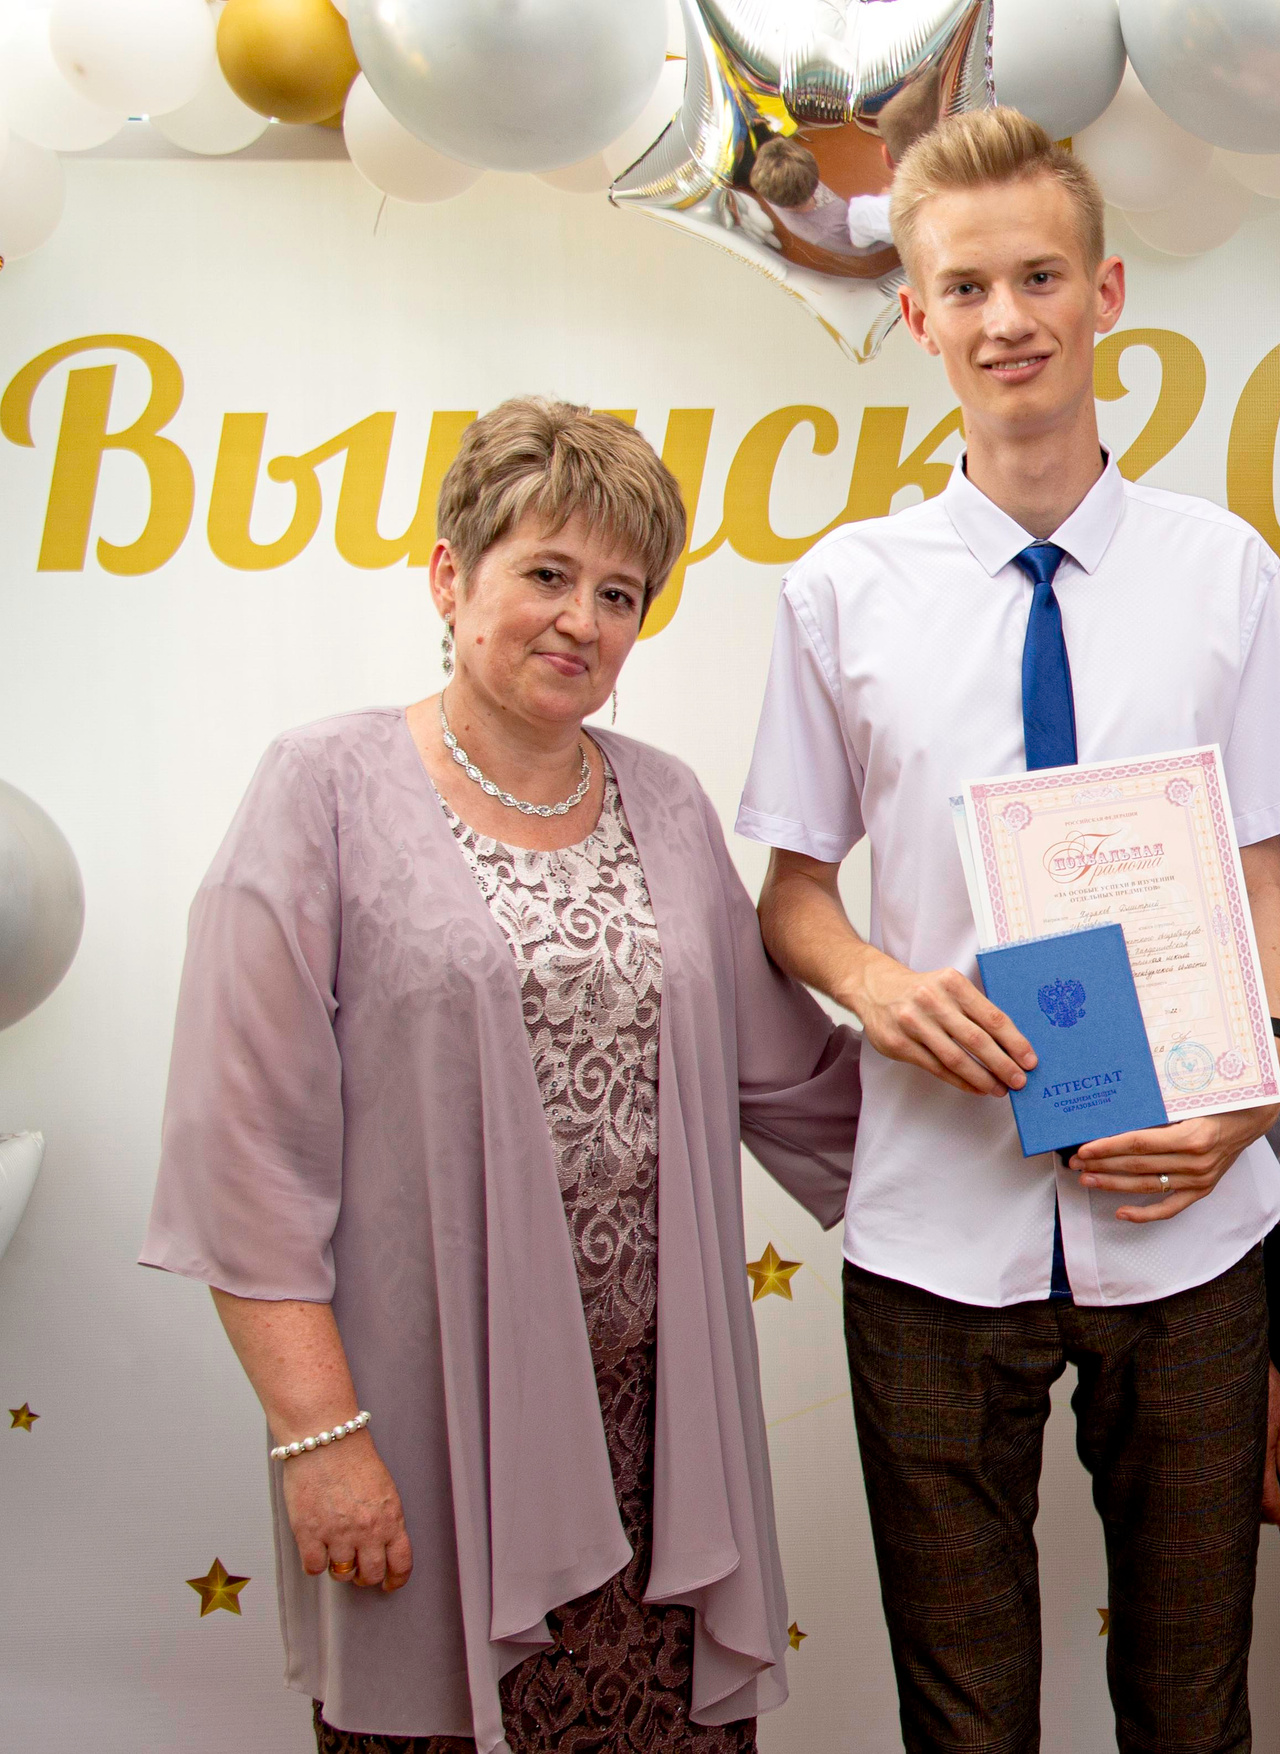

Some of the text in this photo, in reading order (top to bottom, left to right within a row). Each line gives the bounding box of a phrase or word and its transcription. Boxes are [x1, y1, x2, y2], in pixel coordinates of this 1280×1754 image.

[1065, 811, 1139, 827] РОССИЙСКАЯ ФЕДЕРАЦИЯ
[1054, 843, 1165, 871] ПОХВАЛЬНАЯ
[1069, 887, 1099, 897] ОСОБЫЕ
[1100, 882, 1130, 892] УСПЕХИ
[1137, 875, 1176, 887] ИЗУЧЕНИИ
[1070, 892, 1114, 903] ОТДЕЛЬНЫХ
[1042, 1070, 1122, 1099] АТТЕСТАТ
[1060, 1095, 1092, 1107] СРЕДНЕМ
[1092, 1089, 1117, 1101] ОБЩЕМ
[1063, 1097, 1112, 1113] ОБРАЗОВАНИИ
